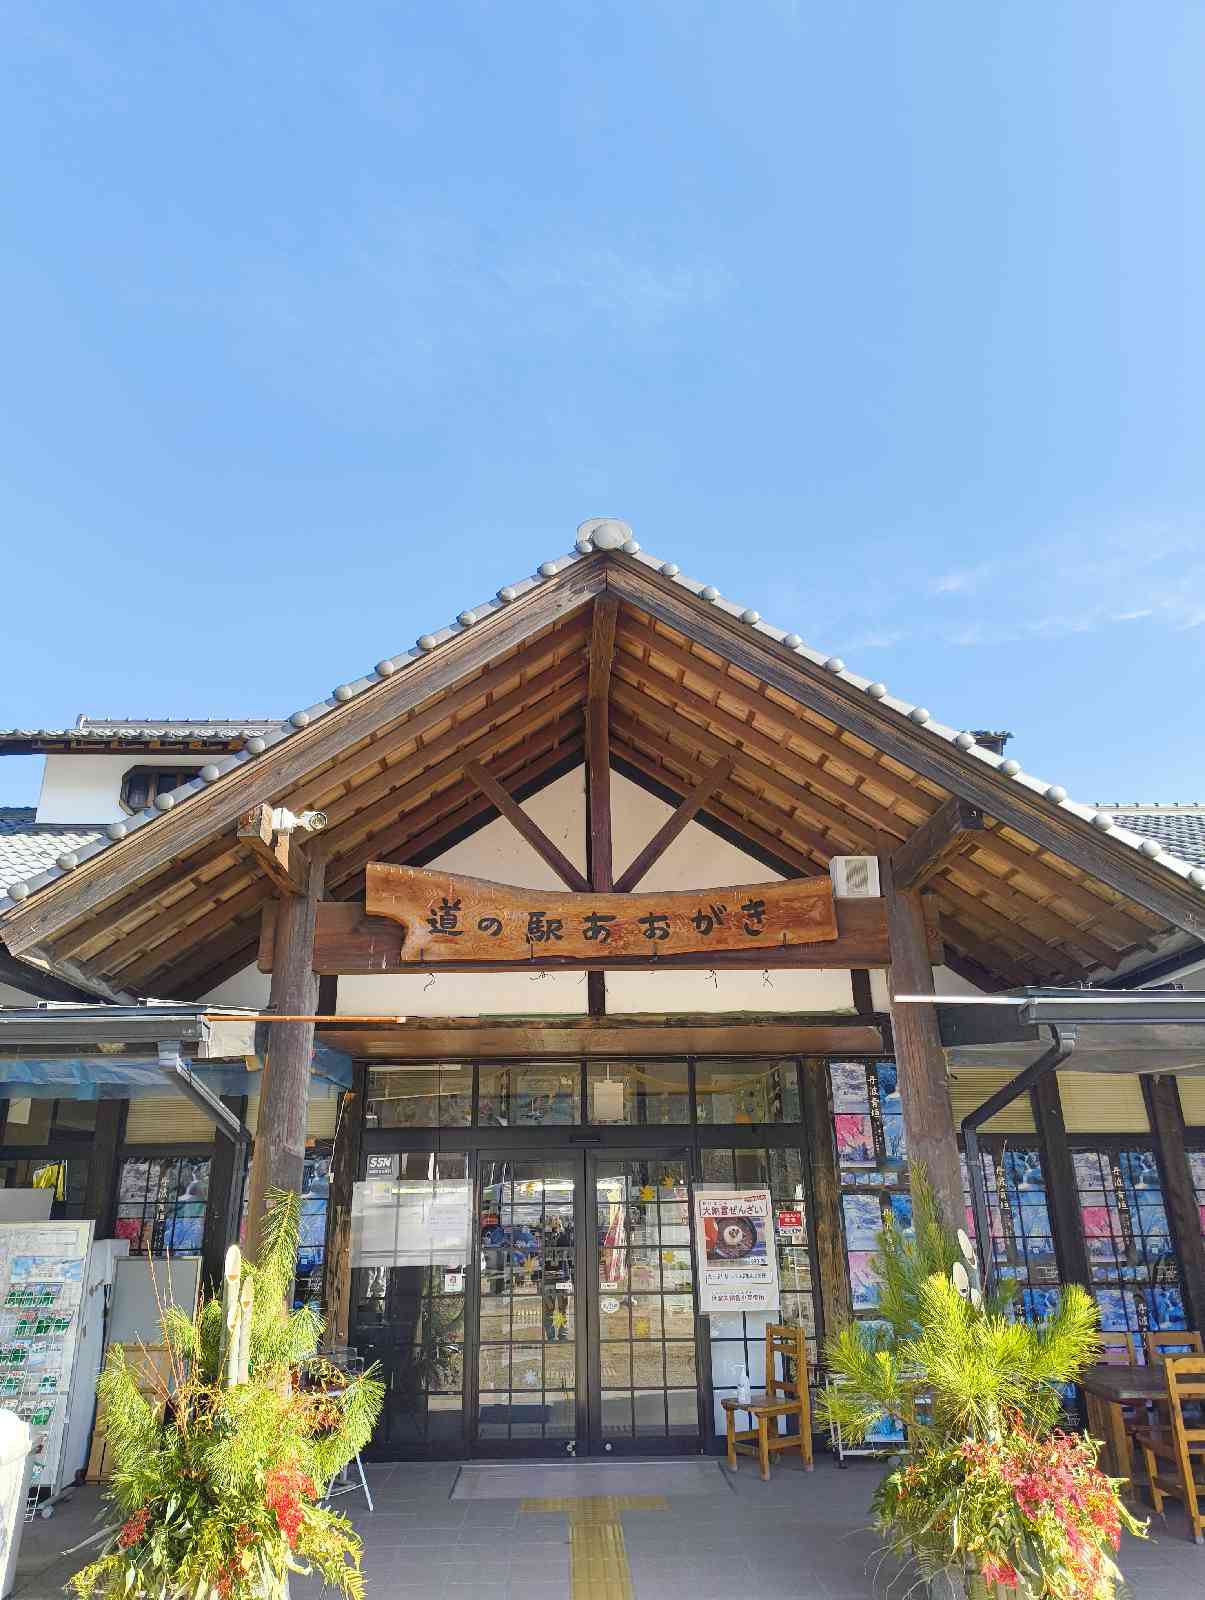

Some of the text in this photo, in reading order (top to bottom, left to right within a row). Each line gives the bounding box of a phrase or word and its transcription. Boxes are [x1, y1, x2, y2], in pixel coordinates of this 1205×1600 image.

[426, 896, 769, 944] 道の駅あおがき
